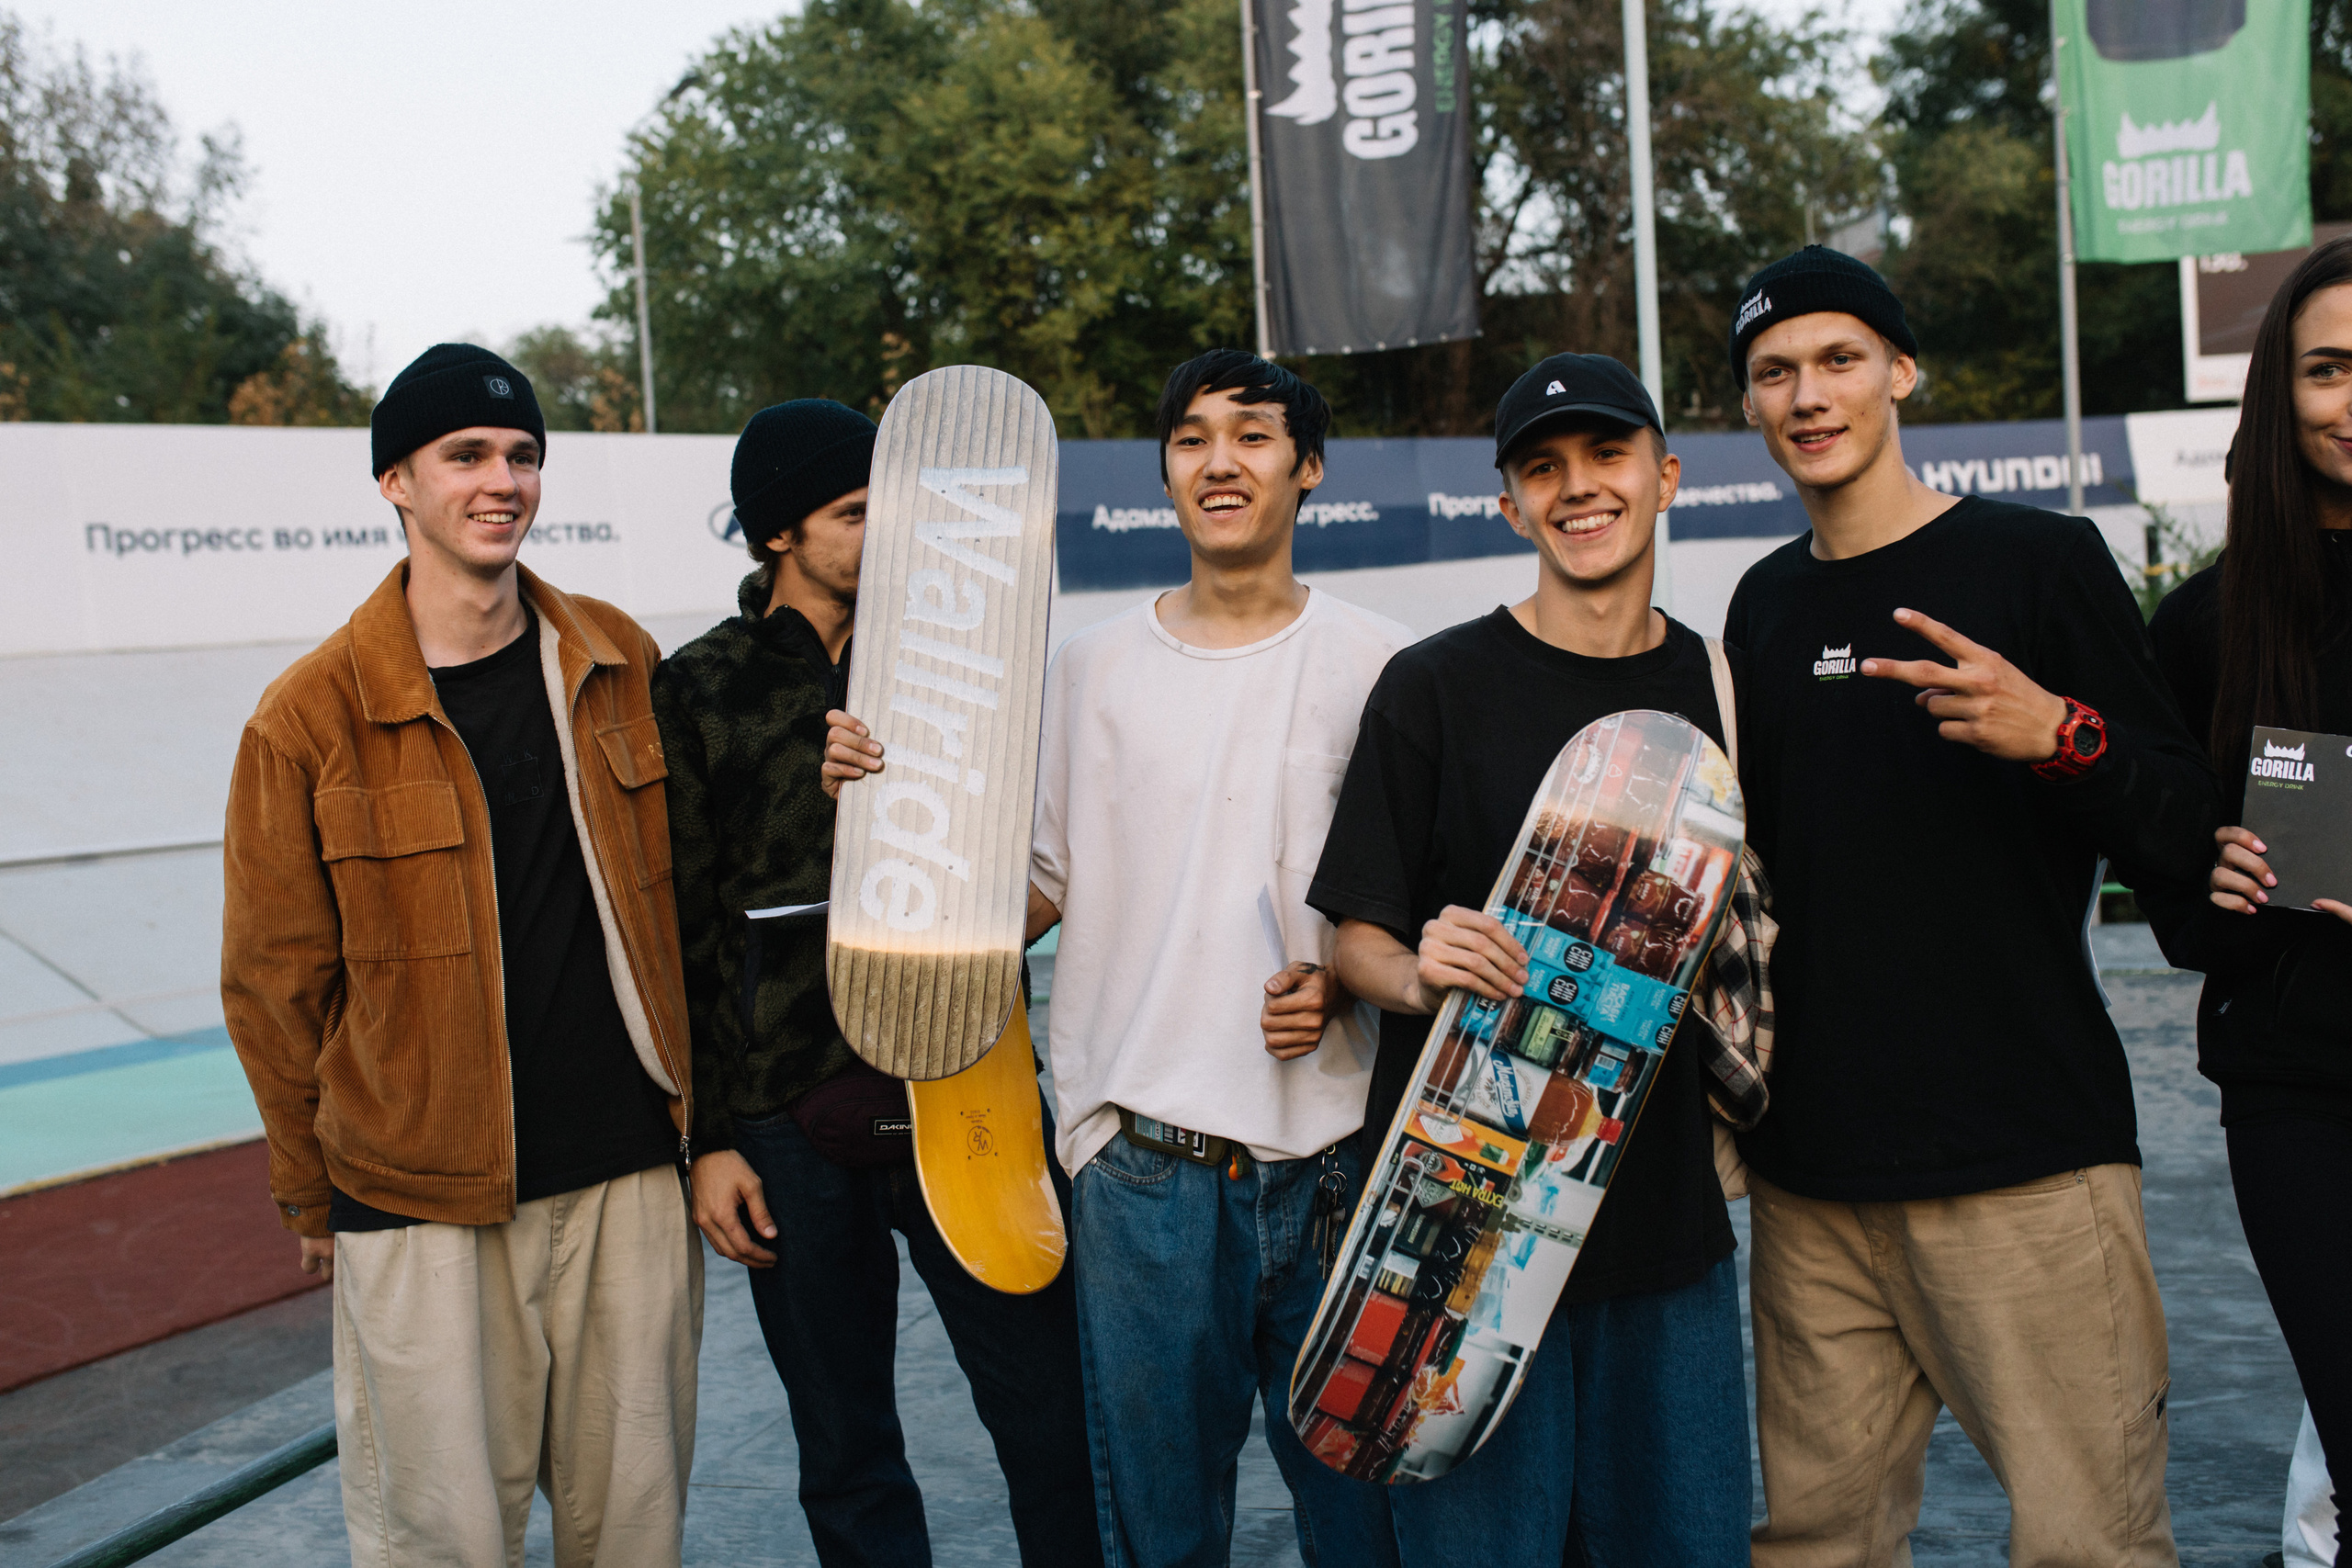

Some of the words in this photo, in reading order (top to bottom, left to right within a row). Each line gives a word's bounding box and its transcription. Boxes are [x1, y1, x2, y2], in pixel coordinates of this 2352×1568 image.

[2102, 149, 2253, 210] GORILLA
[1736, 296, 1772, 336] GORILLA
[1428, 491, 1501, 522] Прогр
[85, 522, 265, 557] Прогресс
[273, 525, 314, 551] во
[322, 525, 389, 549] имя
[1813, 657, 1856, 676] GORILLA
[858, 465, 1030, 932] Wallride
[2250, 757, 2315, 782] GORILLA
[2257, 780, 2284, 788] ENERGY
[1449, 1179, 1473, 1195] HOT
[1473, 1188, 1504, 1207] EXTRA
